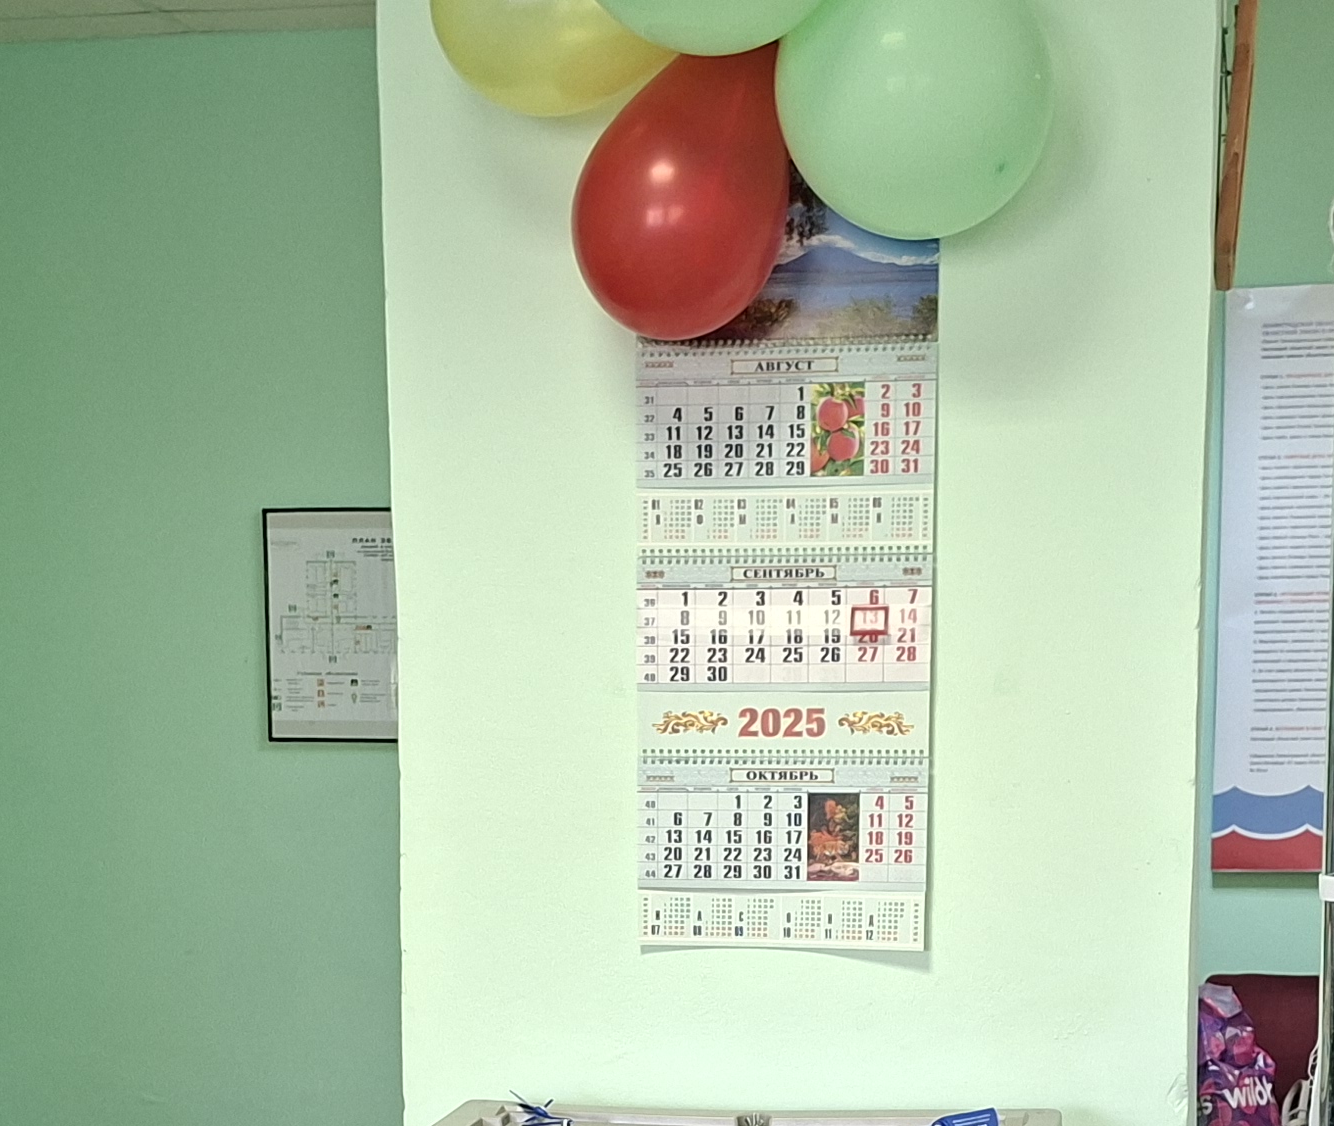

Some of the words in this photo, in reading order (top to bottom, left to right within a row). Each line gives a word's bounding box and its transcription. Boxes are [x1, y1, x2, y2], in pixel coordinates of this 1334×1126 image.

[755, 360, 815, 372] АВГУСТ
[645, 396, 654, 404] 31
[798, 386, 803, 401] 1
[881, 384, 890, 399] 2
[912, 383, 921, 398] 3
[673, 408, 682, 422] 4
[704, 407, 712, 421] 5
[735, 407, 743, 421] 6
[766, 406, 774, 420] 7
[797, 405, 805, 419] 8
[881, 403, 890, 417] 9
[904, 402, 921, 417] 10
[645, 433, 655, 441] 33
[667, 426, 680, 440] 11
[697, 426, 712, 440] 12
[727, 425, 743, 440] 13
[758, 424, 774, 439] 14
[789, 424, 805, 438] 15
[874, 422, 890, 436] 16
[904, 421, 921, 435] 17
[644, 451, 655, 460] 34
[666, 445, 682, 459] 18
[697, 444, 712, 458] 19
[725, 444, 743, 458] 20
[756, 443, 772, 458] 21
[786, 443, 805, 457] 22
[870, 440, 889, 455] 23
[901, 440, 920, 455] 24
[645, 470, 655, 478] 35
[664, 463, 682, 477] 25
[694, 463, 712, 477] 26
[725, 462, 743, 476] 27
[755, 462, 774, 476] 28
[786, 461, 804, 475] 29
[870, 459, 889, 474] 30
[901, 458, 918, 473] 31
[743, 567, 825, 580] СЕНТЯБРЬ
[644, 599, 655, 607] 36
[682, 592, 688, 606] 1
[718, 592, 727, 606] 2
[756, 591, 765, 606] 3
[793, 591, 803, 605] 4
[832, 590, 841, 605] 5
[869, 590, 879, 605] 6
[908, 589, 918, 604] 7
[644, 617, 655, 626] 37
[681, 611, 689, 625] 8
[718, 611, 727, 625] 9
[749, 610, 765, 625] 10
[787, 610, 801, 624] 11
[824, 610, 840, 624] 12
[862, 610, 879, 624] 13
[900, 609, 917, 623] 14
[644, 636, 655, 644] 38
[673, 629, 690, 644] 15
[711, 630, 727, 644] 16
[749, 630, 764, 644] 17
[787, 629, 803, 644] 18
[825, 629, 840, 644] 19
[897, 628, 915, 643] 21
[644, 655, 655, 663] 39
[670, 648, 689, 663] 22
[708, 648, 727, 663] 23
[745, 648, 765, 663] 24
[783, 647, 802, 662] 25
[821, 647, 840, 662] 26
[858, 646, 878, 662] 27
[896, 646, 916, 661] 28
[644, 673, 655, 682] 40
[670, 667, 689, 681] 29
[707, 666, 727, 681] 30
[738, 708, 826, 738] 2025
[746, 770, 819, 782] ОКТЯБРЬ
[734, 796, 741, 809] 1
[764, 795, 772, 809] 2
[794, 796, 802, 809] 3
[875, 796, 884, 810] 4
[905, 796, 913, 810] 5
[646, 818, 655, 826] 41
[674, 812, 682, 825] 6
[704, 812, 712, 826] 7
[734, 813, 742, 826] 8
[764, 813, 772, 826] 9
[787, 813, 802, 826] 10
[869, 813, 882, 827] 11
[898, 814, 913, 828] 12
[666, 830, 682, 843] 13
[696, 830, 712, 843] 14
[726, 830, 742, 844] 15
[756, 830, 772, 844] 16
[786, 830, 802, 844] 17
[868, 831, 883, 845] 18
[897, 831, 913, 845] 19
[645, 853, 655, 861] 43
[664, 847, 682, 860] 20
[695, 847, 710, 861] 21
[724, 848, 741, 861] 22
[754, 848, 772, 861] 23
[784, 848, 801, 862] 24
[865, 849, 883, 862] 25
[894, 849, 912, 863] 26
[645, 870, 655, 878] 44
[664, 864, 682, 878] 27
[694, 865, 711, 878] 28
[724, 865, 741, 878] 29
[754, 865, 771, 879] 30
[784, 866, 800, 879] 31
